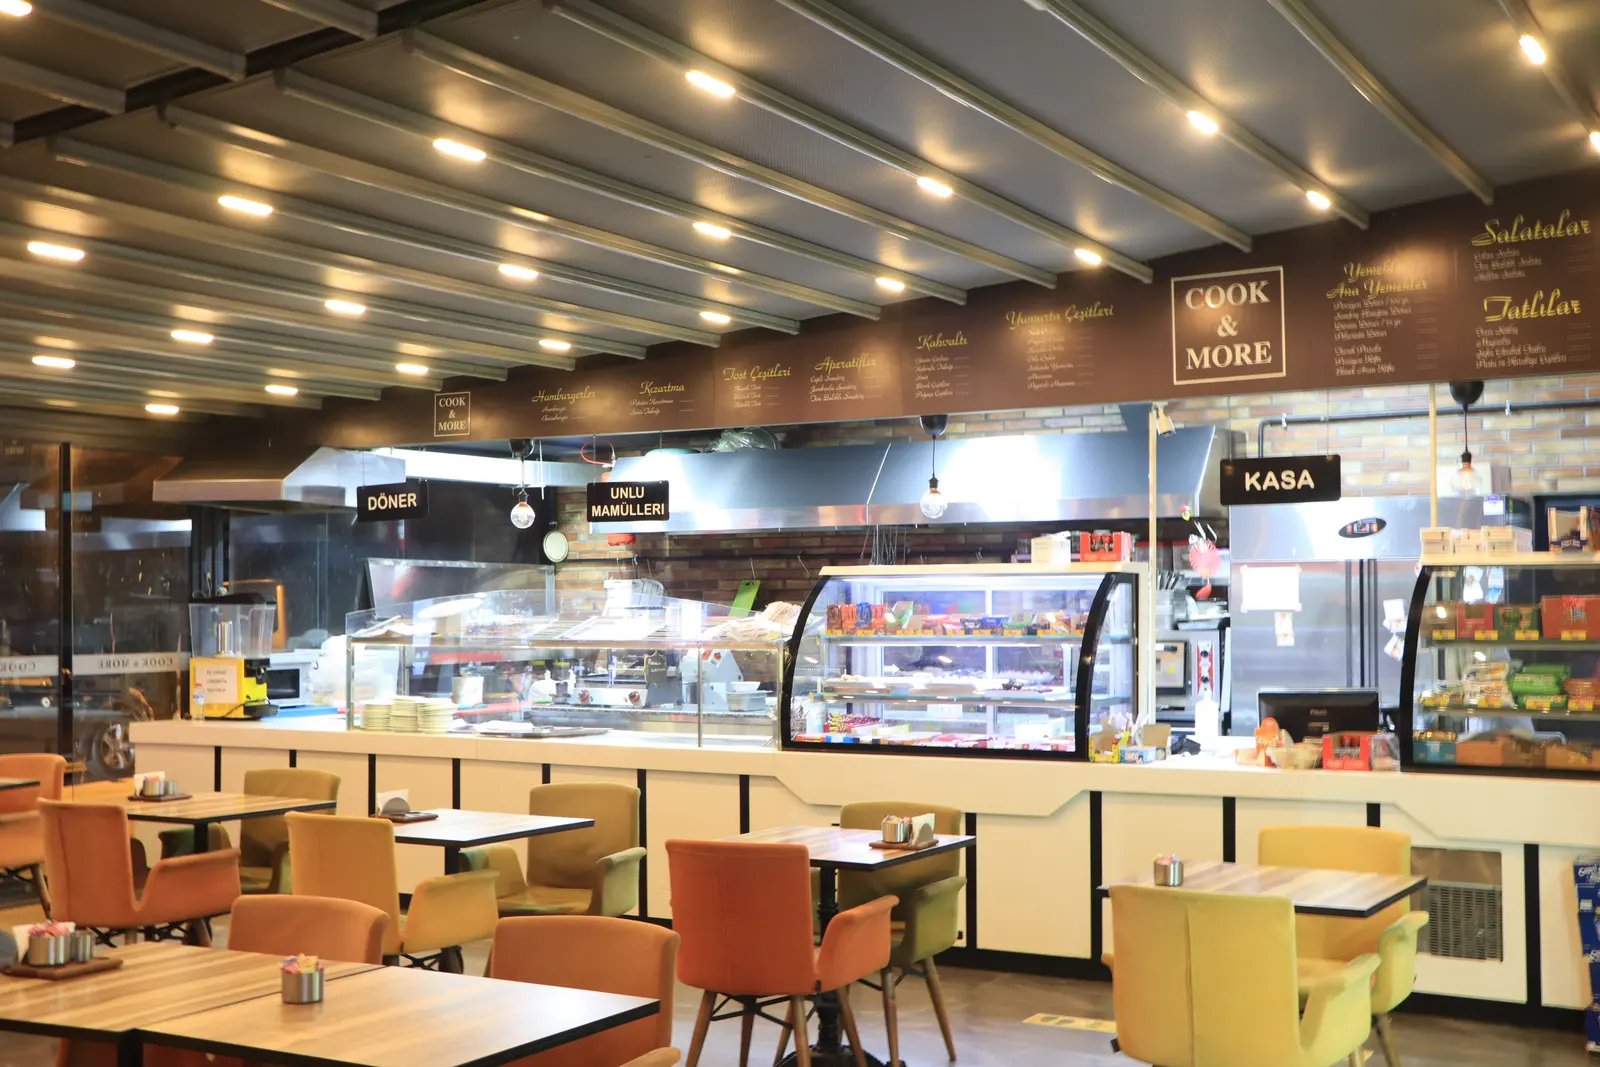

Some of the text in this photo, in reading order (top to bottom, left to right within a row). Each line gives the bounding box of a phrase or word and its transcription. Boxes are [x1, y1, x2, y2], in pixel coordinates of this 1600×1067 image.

[1471, 208, 1592, 246] Salatalar
[1185, 280, 1270, 311] COOK
[1483, 288, 1582, 322] Tatlılar
[1005, 300, 1114, 330] Yumurta Çeşitleri
[1216, 314, 1238, 338] &
[915, 330, 969, 351] Kahvaltı
[814, 353, 877, 375] Aperatifler
[1185, 341, 1272, 371] MORE
[722, 367, 748, 381] Tost
[750, 363, 792, 382] Çeşitleri
[531, 384, 596, 405] Hamburgerler
[638, 381, 685, 397] Kızartma
[438, 396, 466, 408] COOK
[448, 409, 456, 419] &
[438, 420, 467, 432] MORE
[1244, 469, 1315, 492] KASA
[367, 492, 417, 511] DÖNER
[610, 486, 645, 499] UNLU
